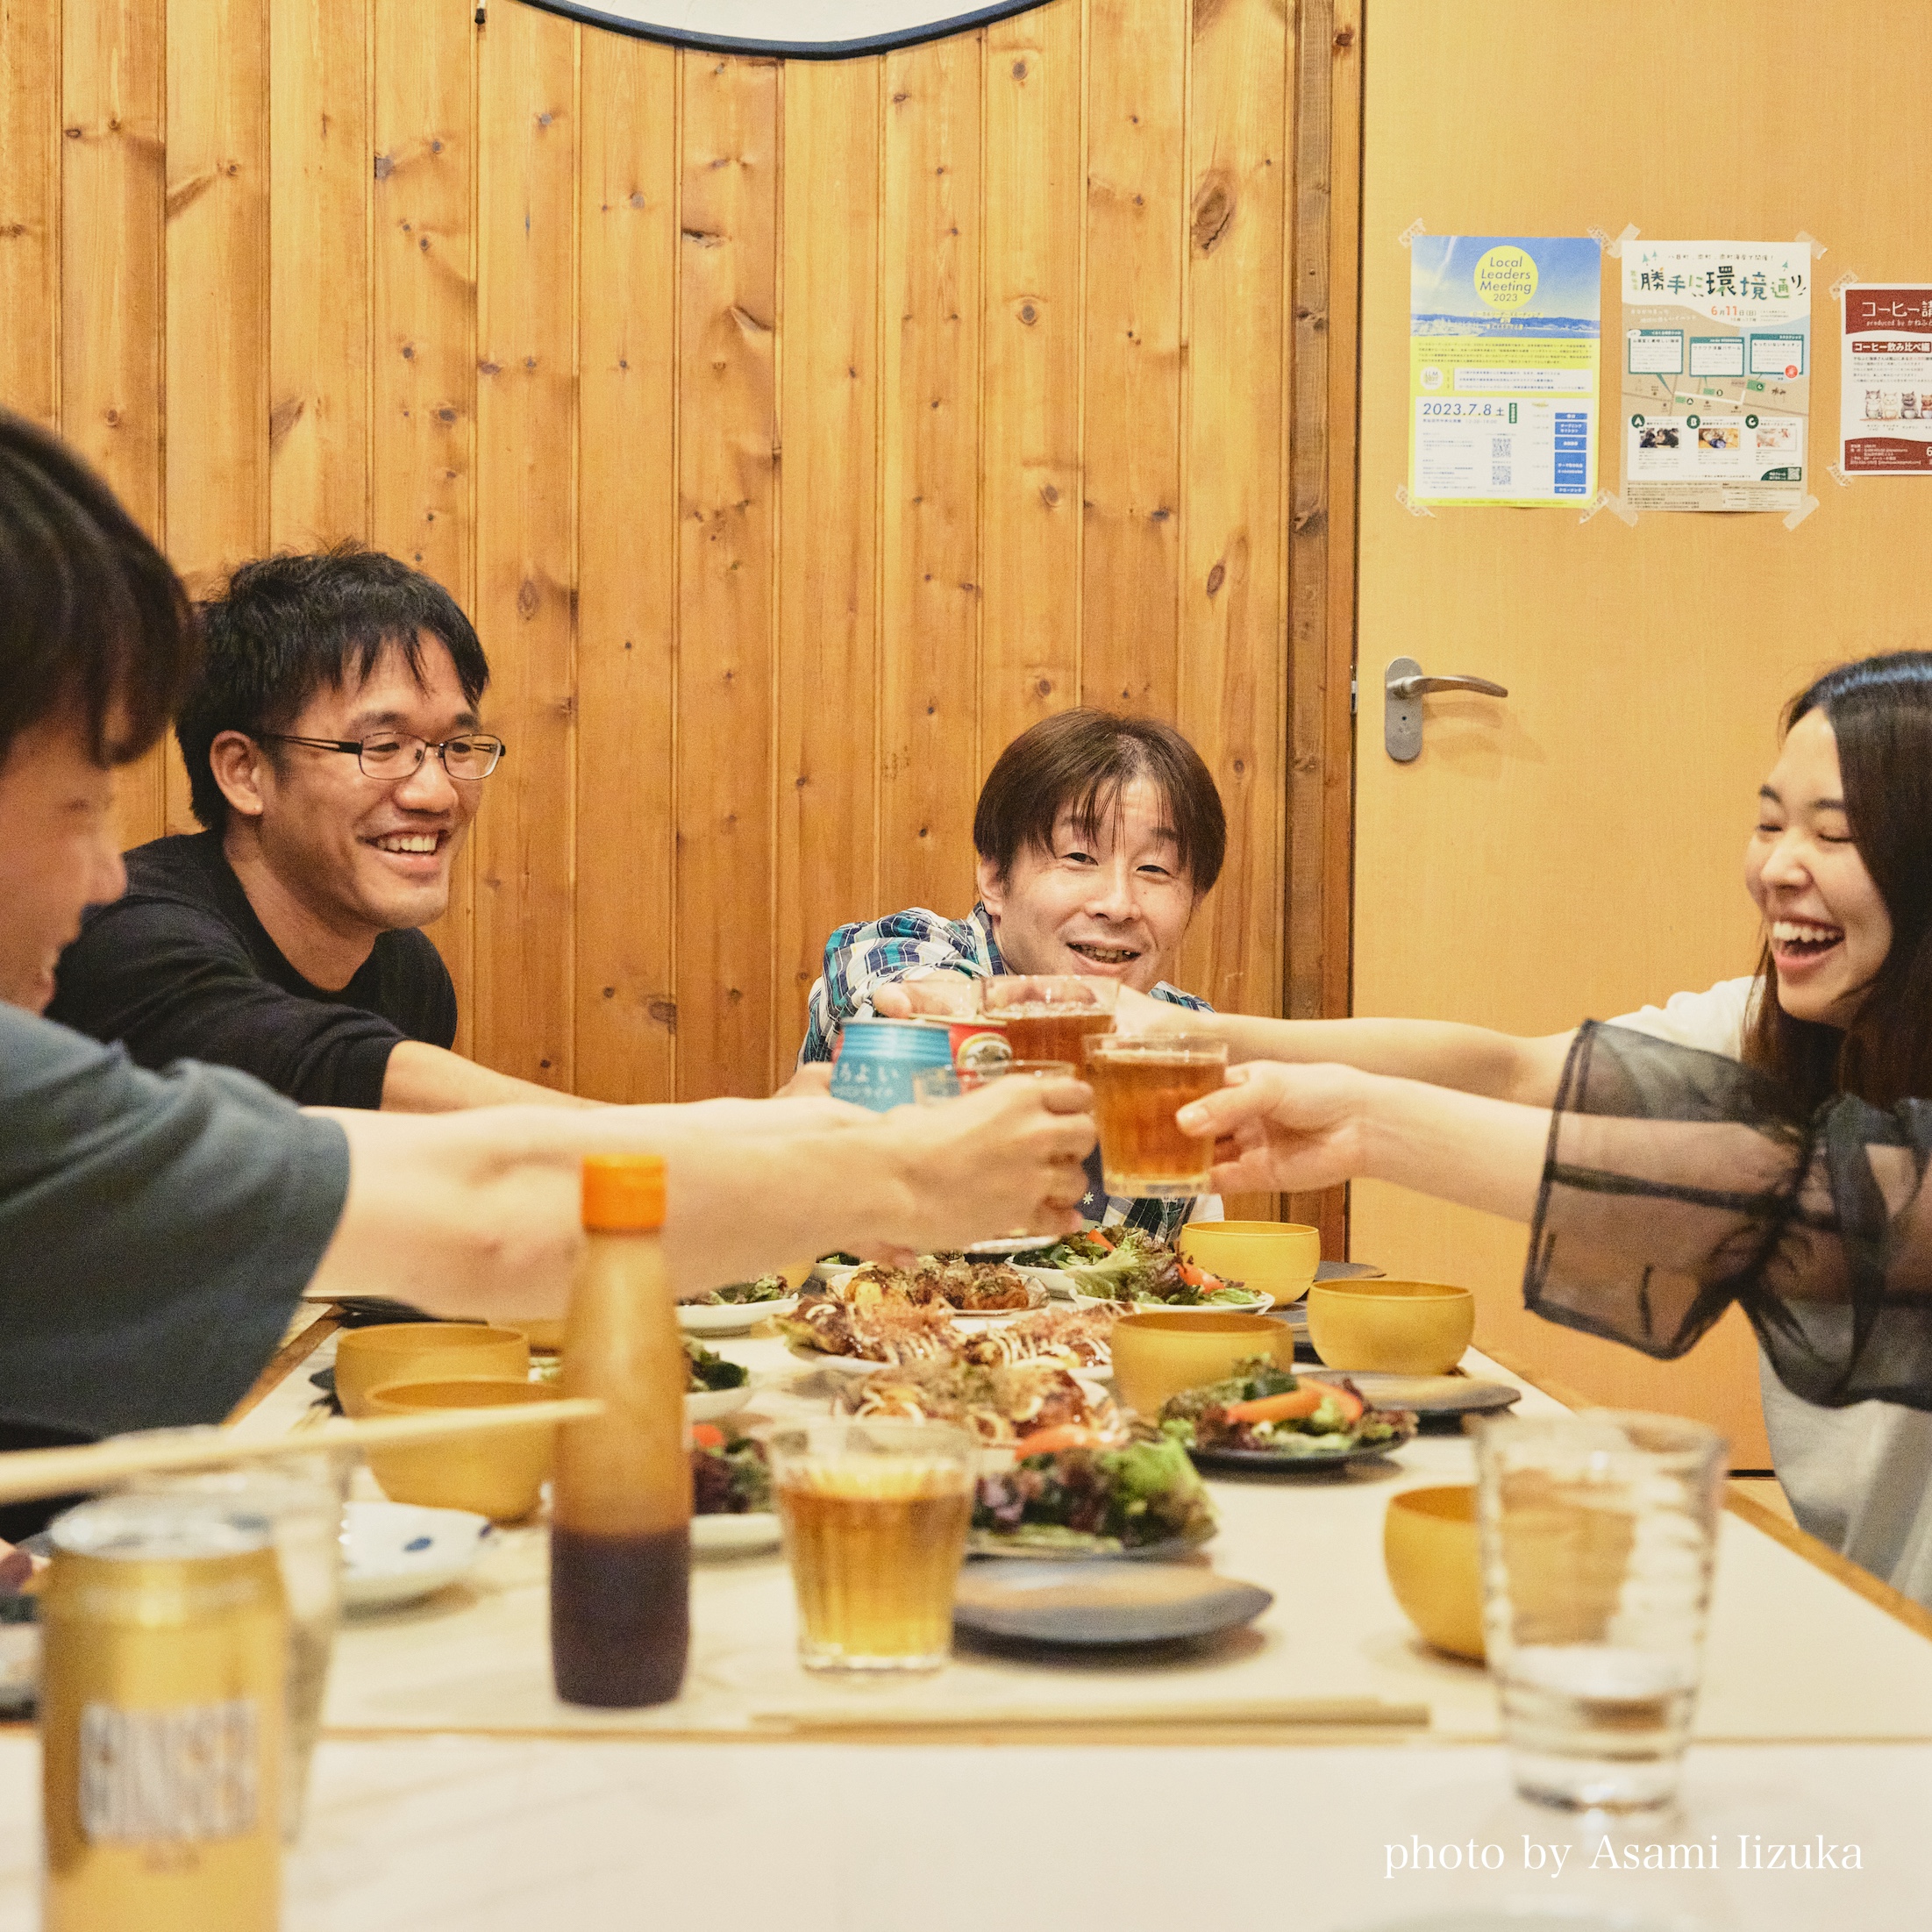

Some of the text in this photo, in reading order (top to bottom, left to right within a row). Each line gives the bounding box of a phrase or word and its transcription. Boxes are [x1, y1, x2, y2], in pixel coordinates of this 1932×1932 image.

[1490, 256, 1522, 267] Local
[1481, 268, 1530, 280] Leaders
[1479, 281, 1531, 295] Meeting
[1641, 266, 1802, 300] 勝手に環境通り
[1493, 293, 1518, 302] 2023
[1422, 403, 1492, 416] 2023.7.8
[1496, 407, 1505, 417] 土
